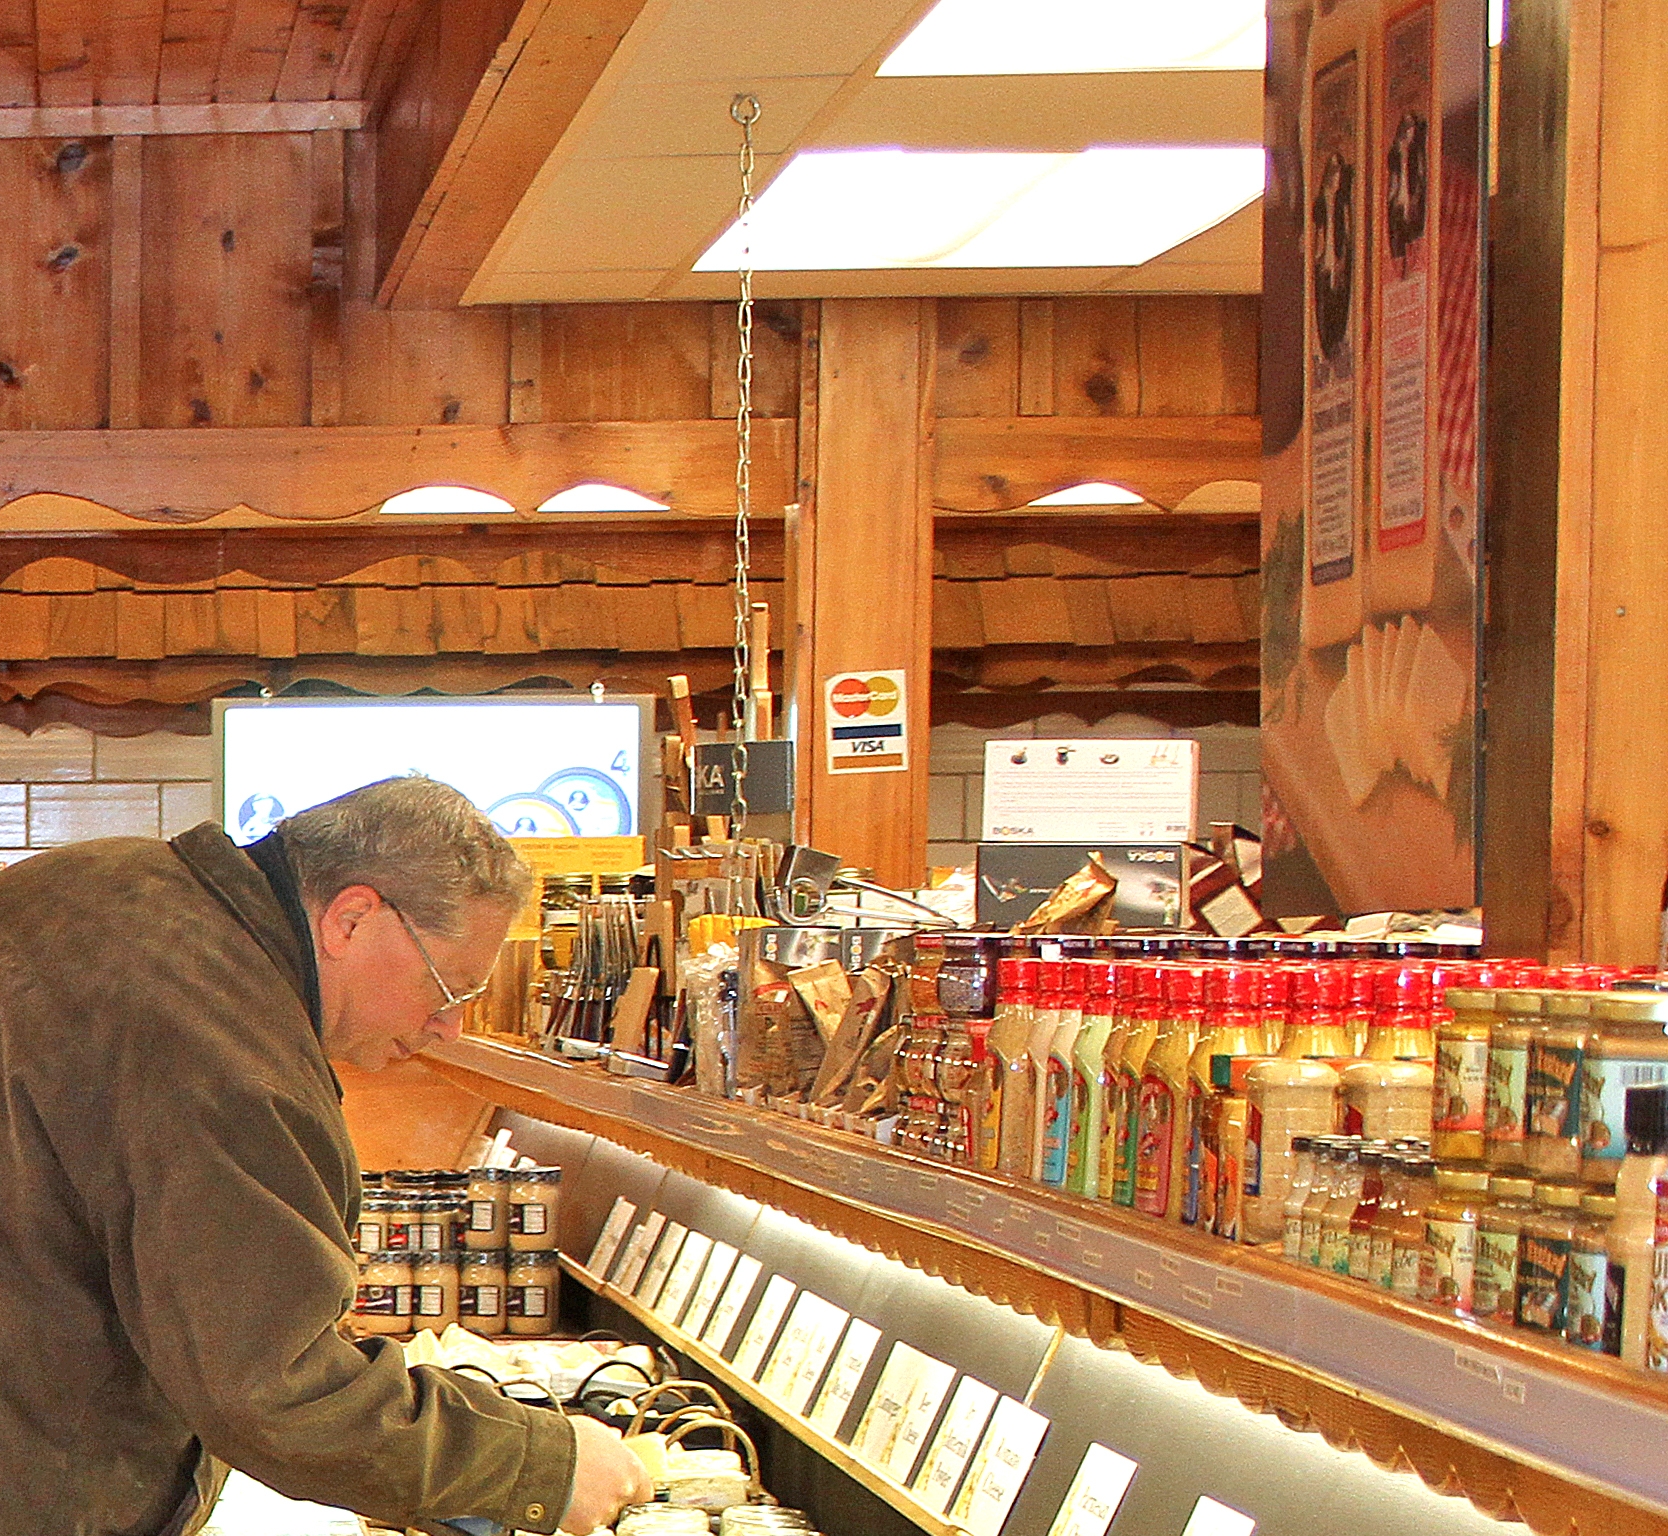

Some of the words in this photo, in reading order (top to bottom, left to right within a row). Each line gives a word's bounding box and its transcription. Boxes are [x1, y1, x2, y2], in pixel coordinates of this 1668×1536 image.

[832, 691, 898, 703] MasterCard
[851, 740, 885, 752] VISA
[992, 826, 1034, 836] BOSKA
[1127, 850, 1176, 863] BOSKA
